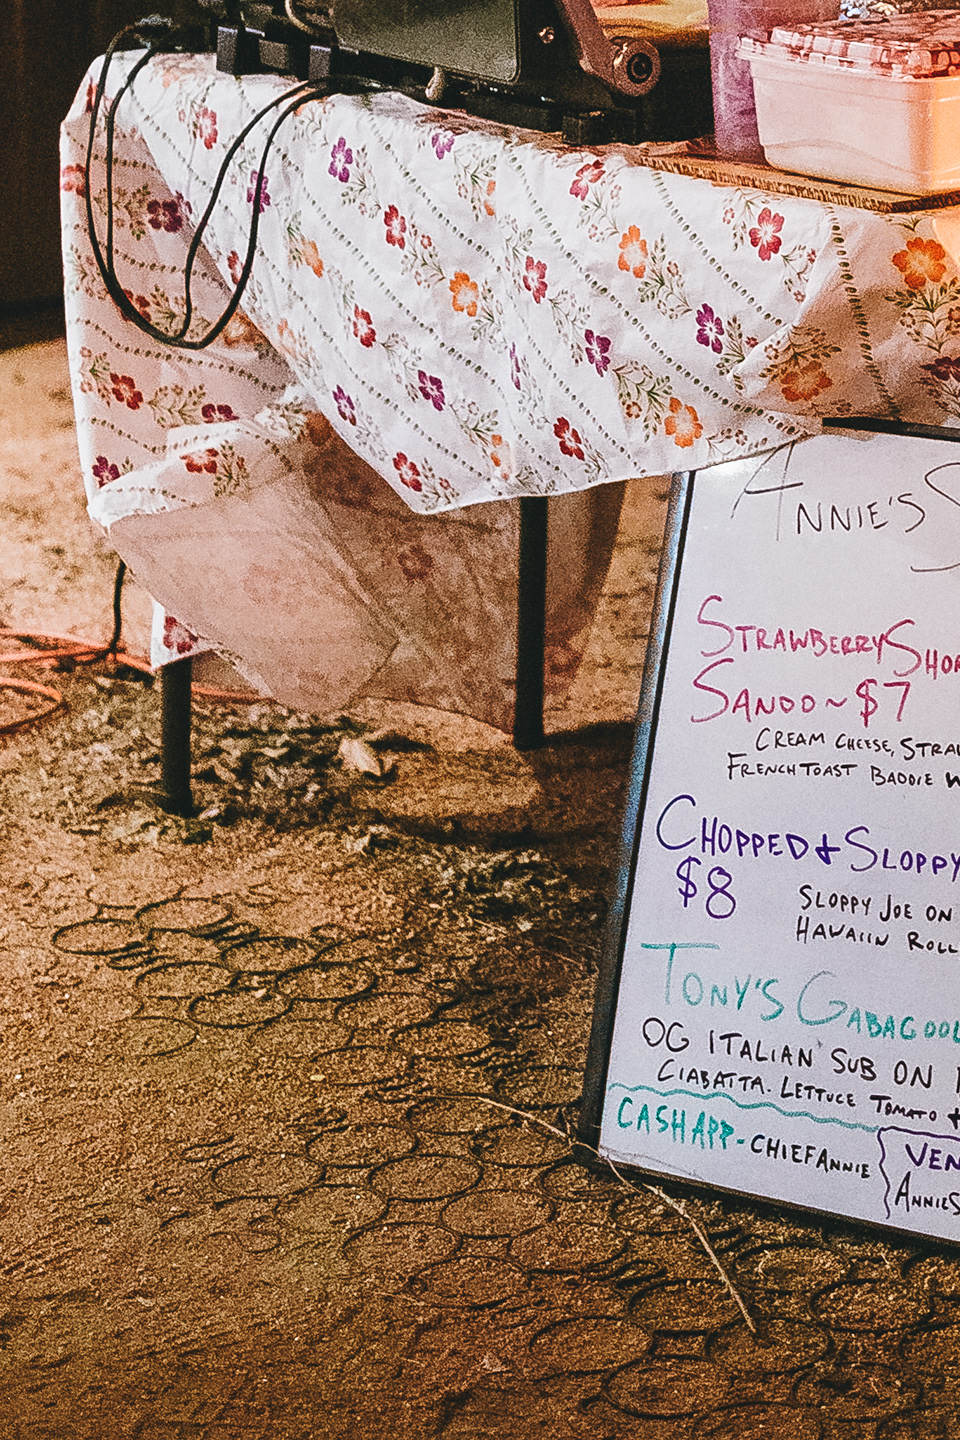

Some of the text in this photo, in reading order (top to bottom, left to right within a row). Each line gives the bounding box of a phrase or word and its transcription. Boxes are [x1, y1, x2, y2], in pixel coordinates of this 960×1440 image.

[730, 441, 925, 542] ANNIE'S
[697, 595, 886, 664] STRAWBERRY
[691, 658, 816, 723] SANDO
[856, 678, 912, 728] $7
[727, 752, 796, 780] FRENCH
[799, 762, 859, 777] TOAST
[870, 765, 934, 787] BADDIE
[755, 727, 826, 751] CREAM
[835, 733, 895, 757] CHEESE,
[656, 794, 810, 861] CHOPPED
[676, 855, 737, 920] $8
[799, 884, 872, 916] SLOPPY
[879, 894, 914, 922] JOE
[925, 905, 953, 923] ON
[795, 916, 890, 946] HAWAIIN
[641, 942, 786, 1021] TONY'S
[642, 1016, 690, 1050] OG
[708, 1030, 814, 1066] ITALIAN
[831, 1045, 875, 1082] SUB
[894, 1062, 933, 1090] ON
[779, 1076, 857, 1108] LETTUCE
[869, 1094, 938, 1122] TOMATO
